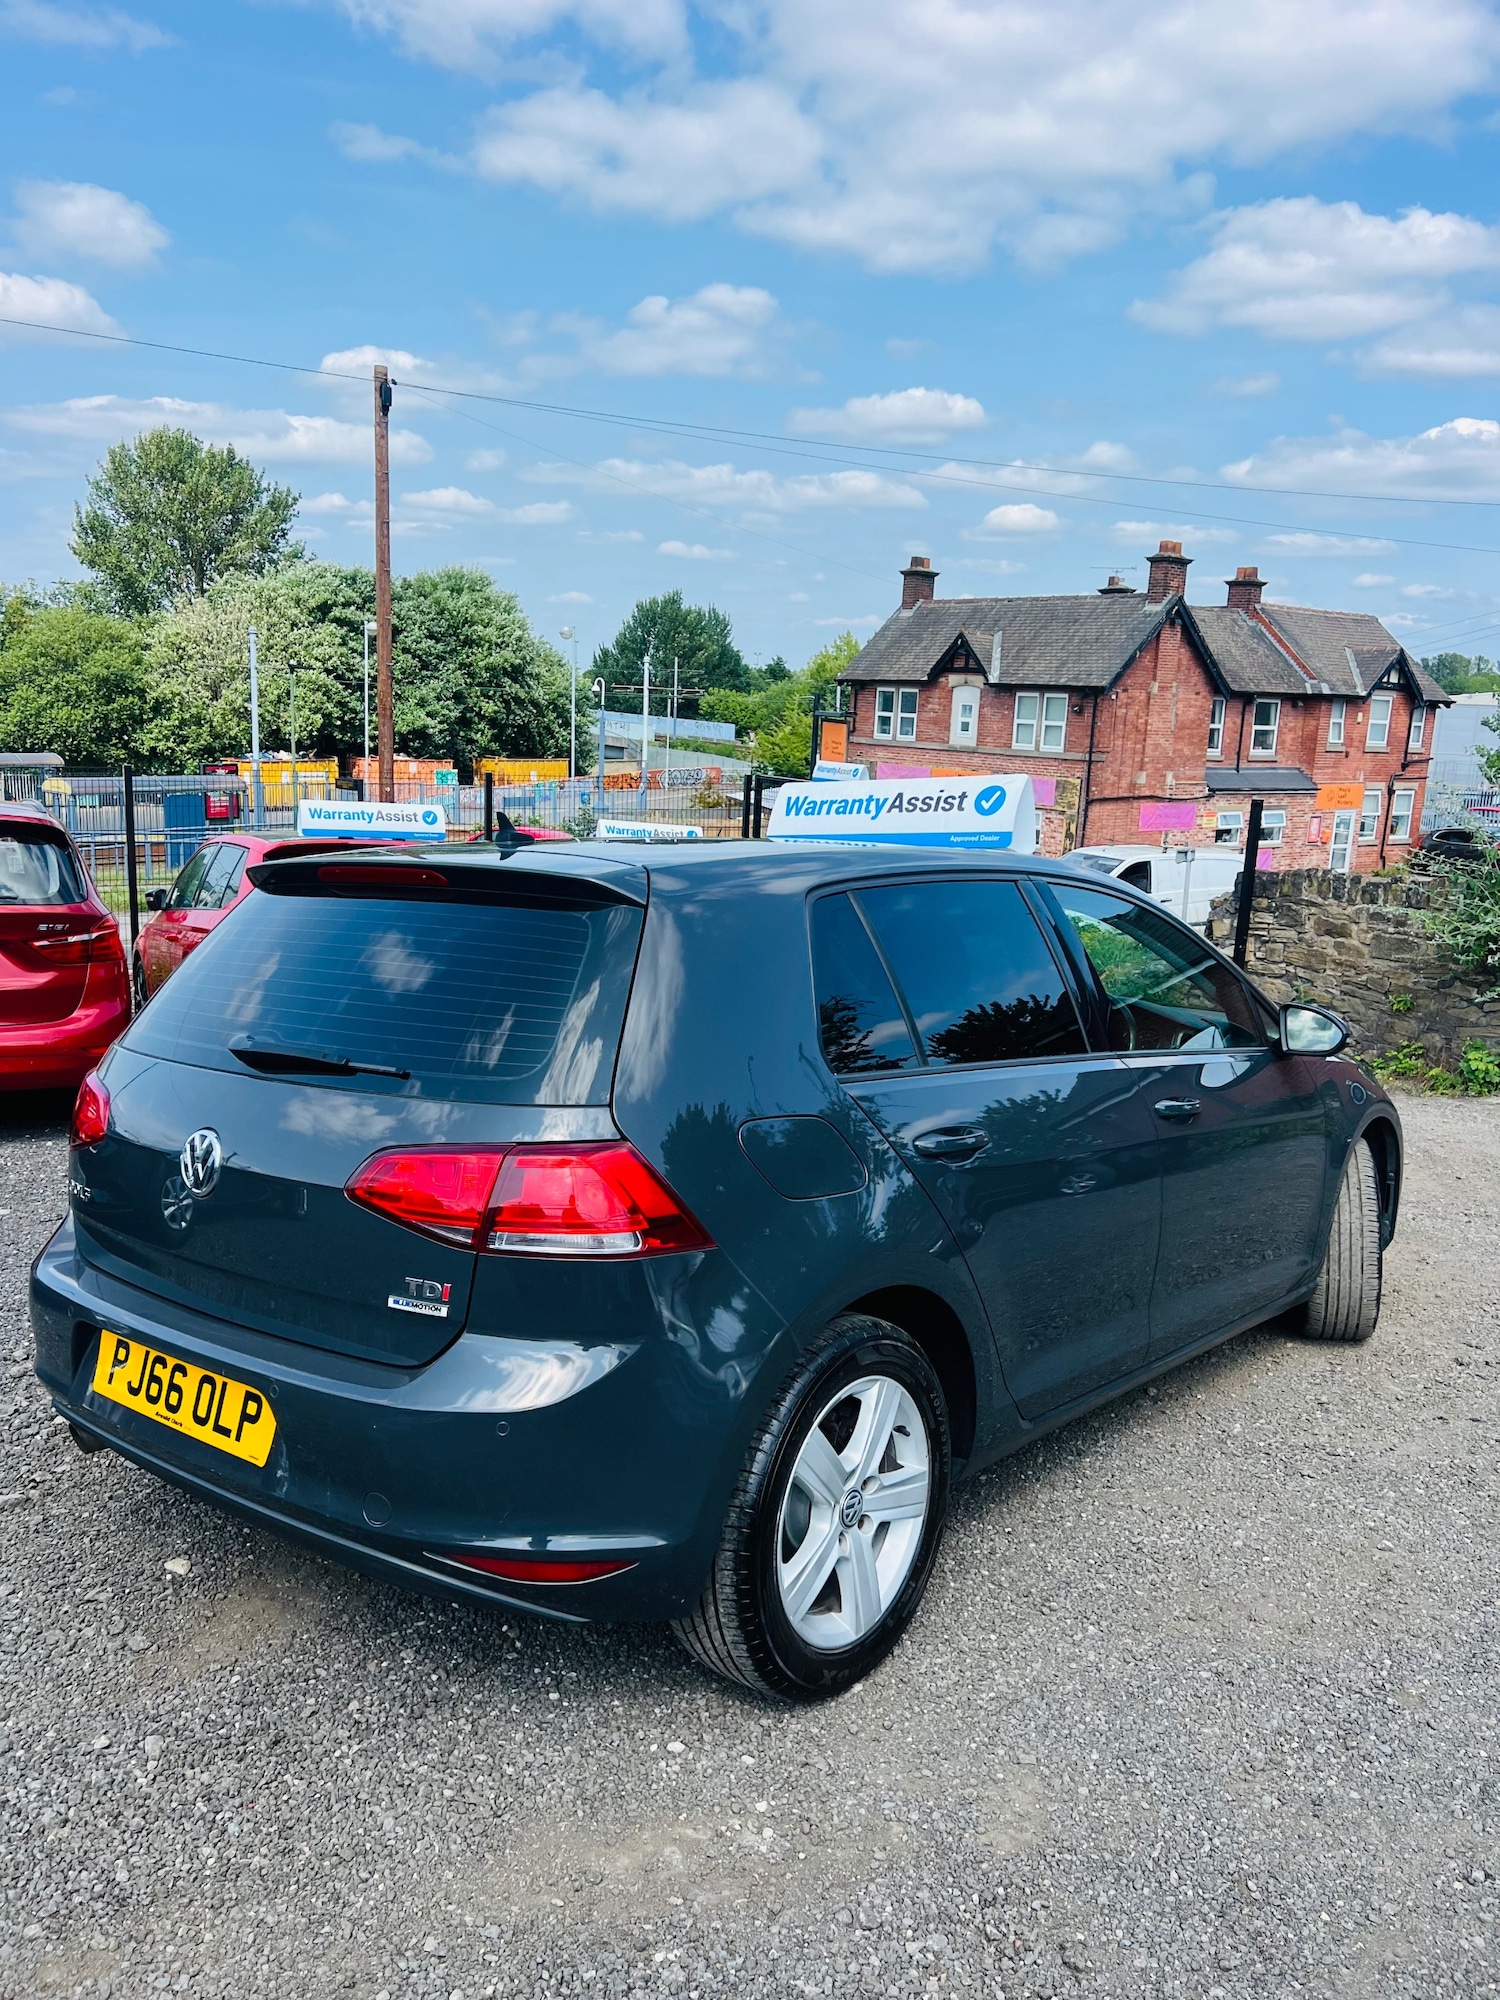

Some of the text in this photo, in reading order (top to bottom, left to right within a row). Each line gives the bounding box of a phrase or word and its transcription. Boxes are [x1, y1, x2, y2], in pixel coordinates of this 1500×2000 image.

[950, 834, 1000, 843] Approved Dealer
[404, 1276, 452, 1302] TDI
[108, 1338, 263, 1443] PJ66 OLP
